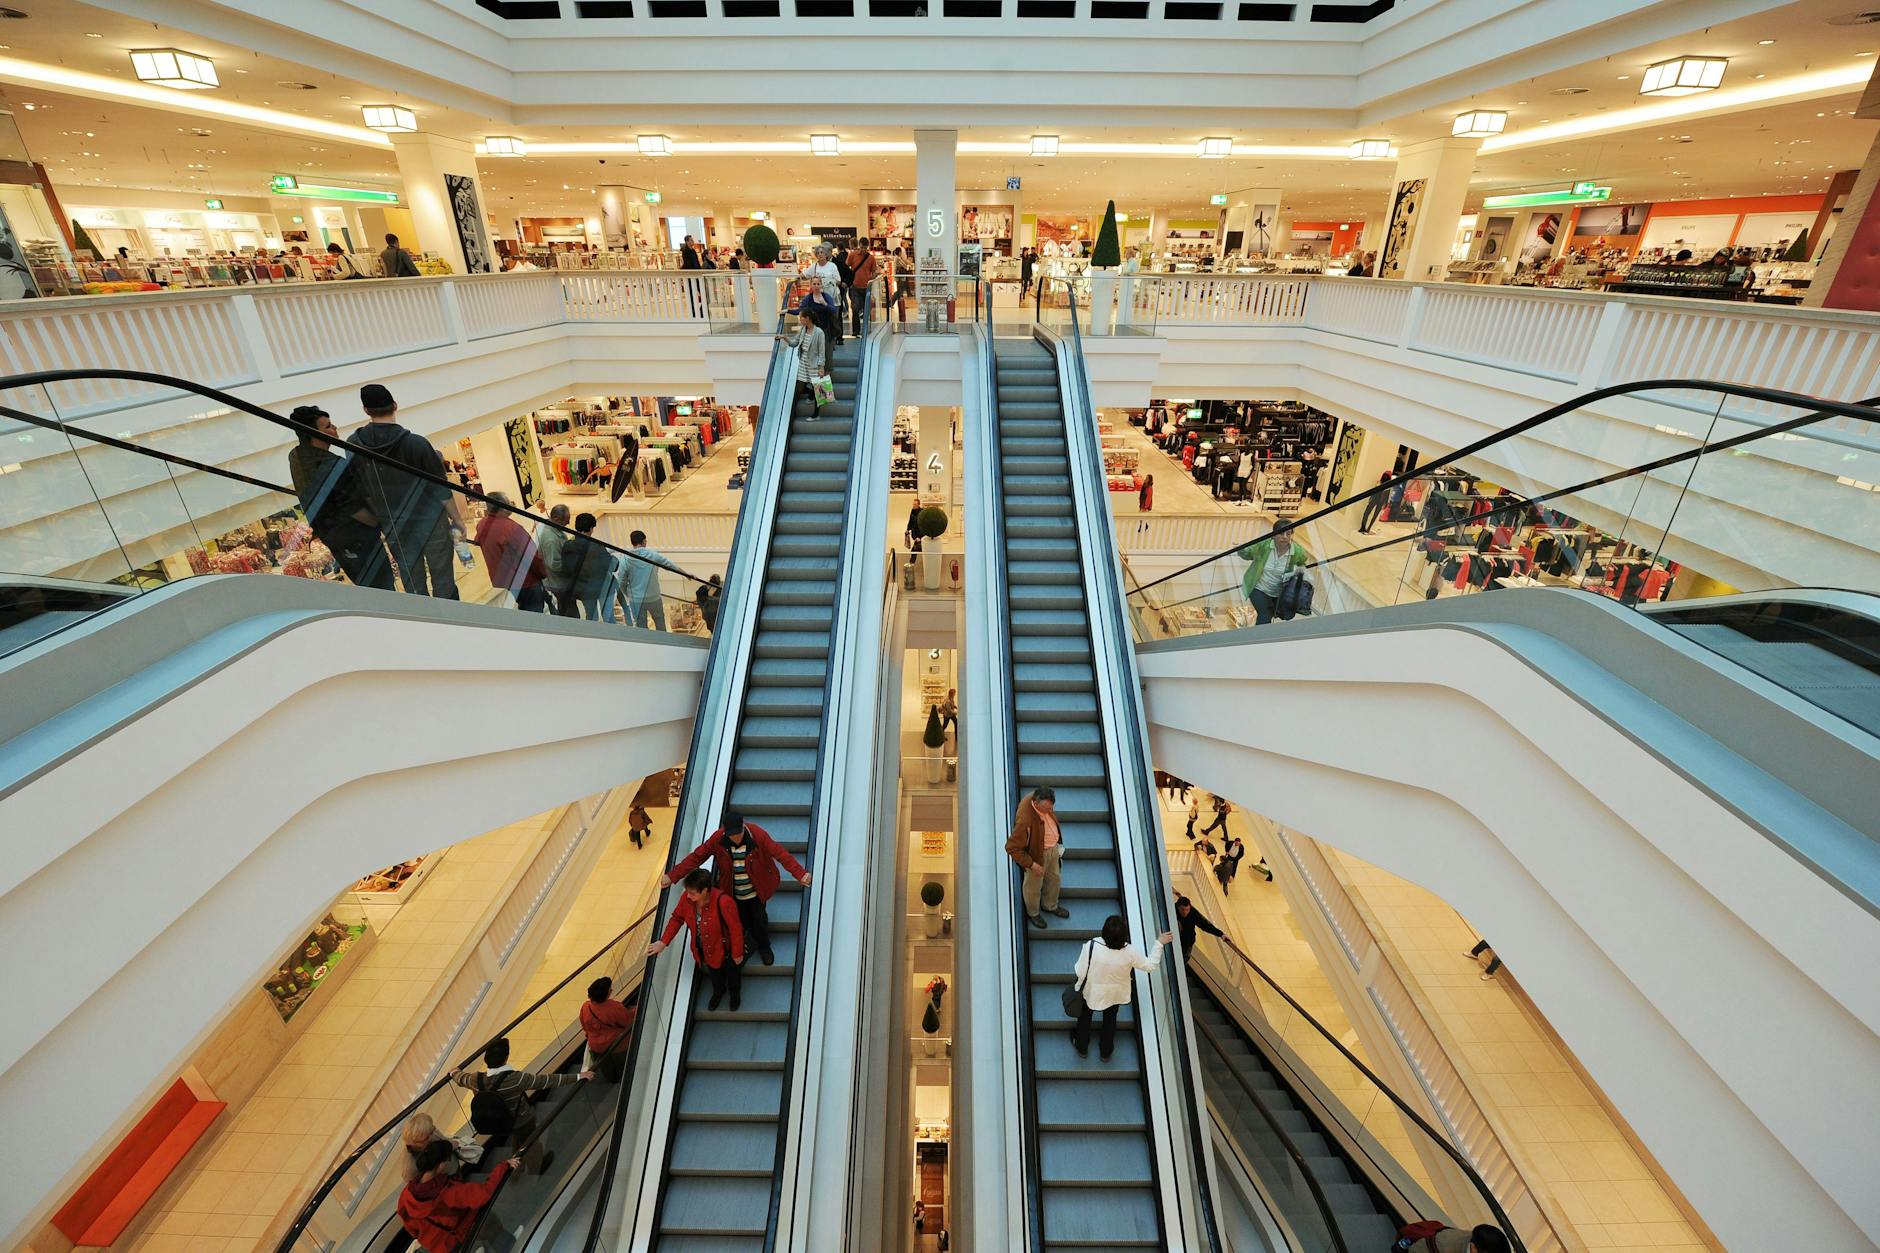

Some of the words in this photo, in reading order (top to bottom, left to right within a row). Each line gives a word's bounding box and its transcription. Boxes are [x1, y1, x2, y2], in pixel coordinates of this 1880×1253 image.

[928, 209, 944, 237] 5
[927, 453, 943, 474] 4
[929, 649, 942, 661] 3
